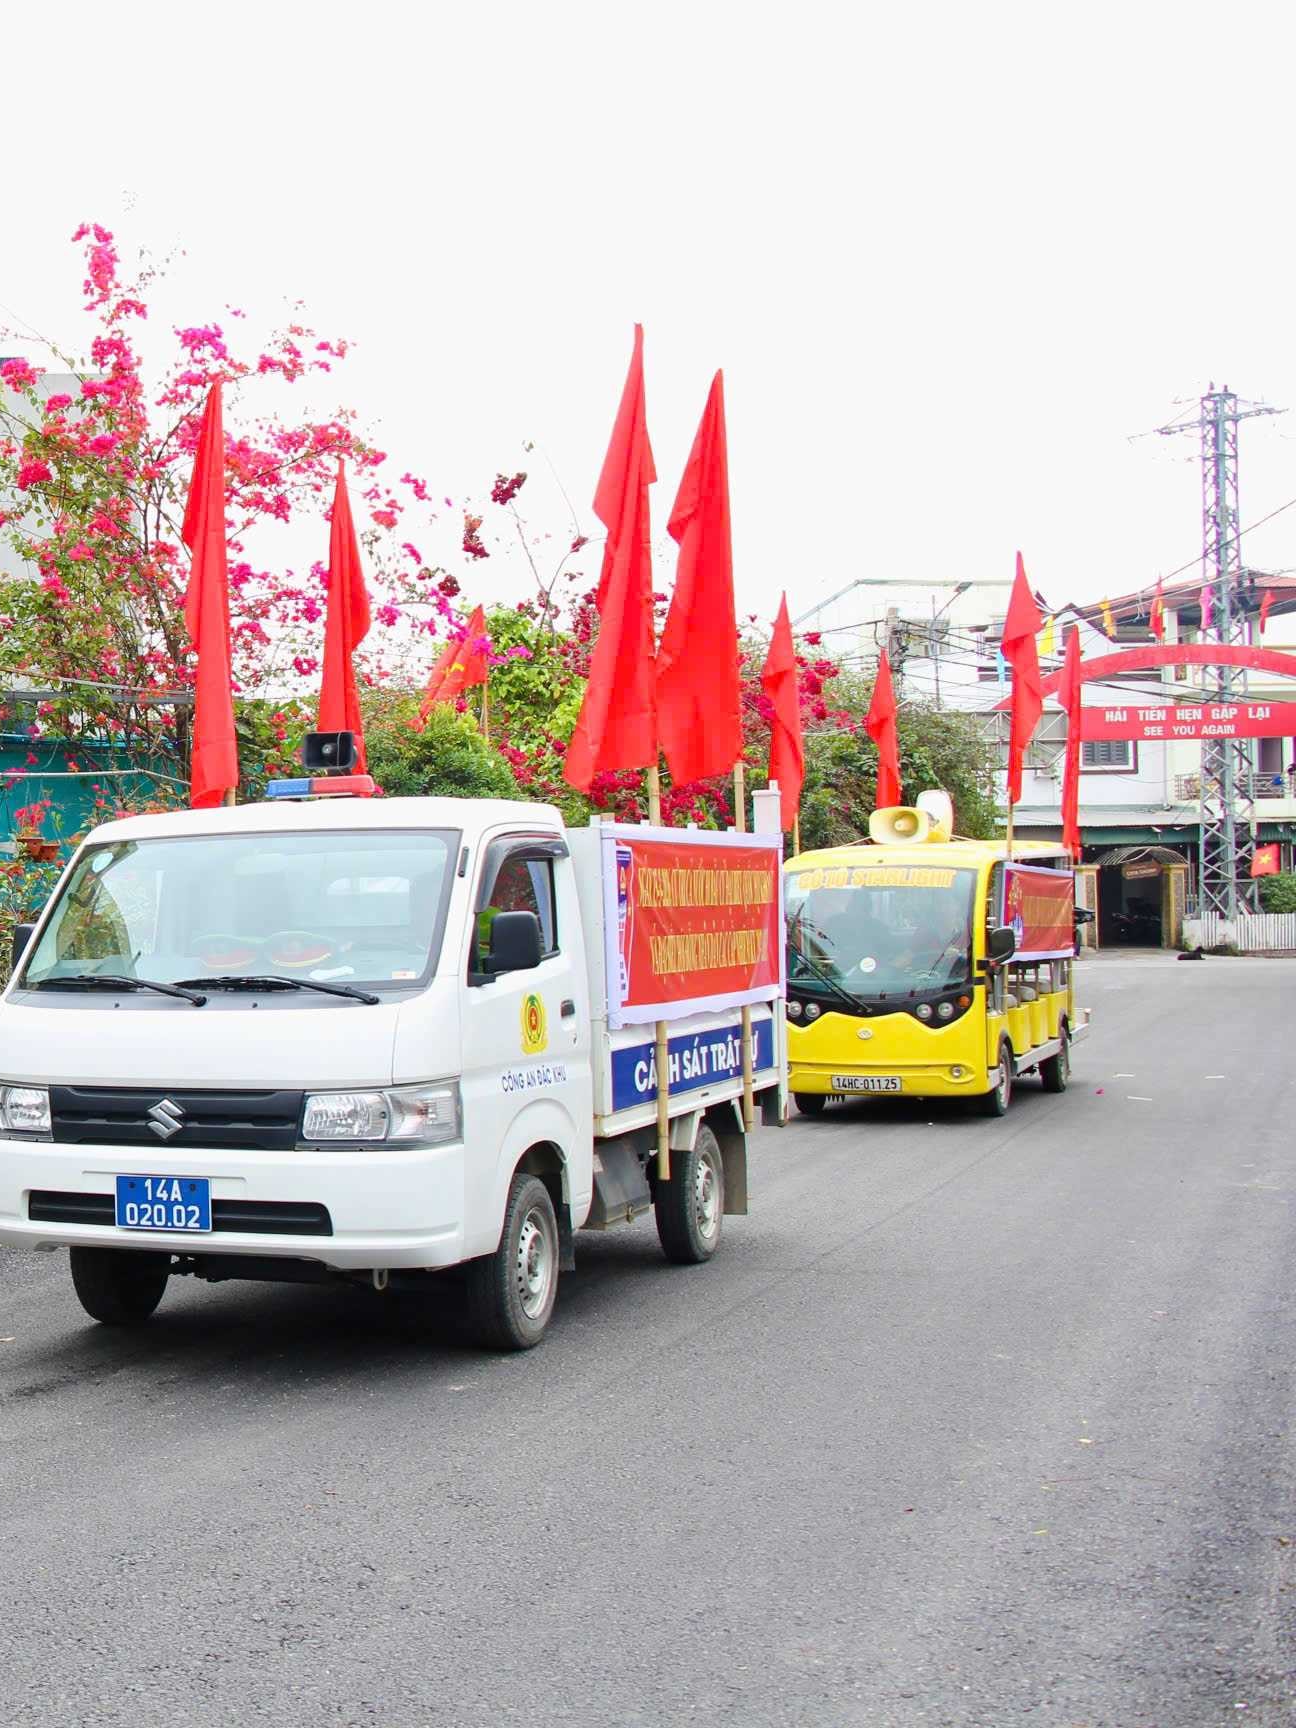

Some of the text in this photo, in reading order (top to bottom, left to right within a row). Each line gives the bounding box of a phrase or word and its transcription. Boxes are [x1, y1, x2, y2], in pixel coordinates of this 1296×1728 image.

[1176, 708, 1202, 723] HẸN
[1144, 724, 1235, 736] SEE YOU AGAIN
[634, 1047, 680, 1092] CẢH
[683, 1036, 708, 1080] SÁT
[710, 1034, 741, 1075] TRẬT
[502, 1064, 566, 1092] CÔNG AN ĐẶC KHU
[144, 1178, 183, 1202] 14A
[125, 1202, 201, 1228] 020.02
